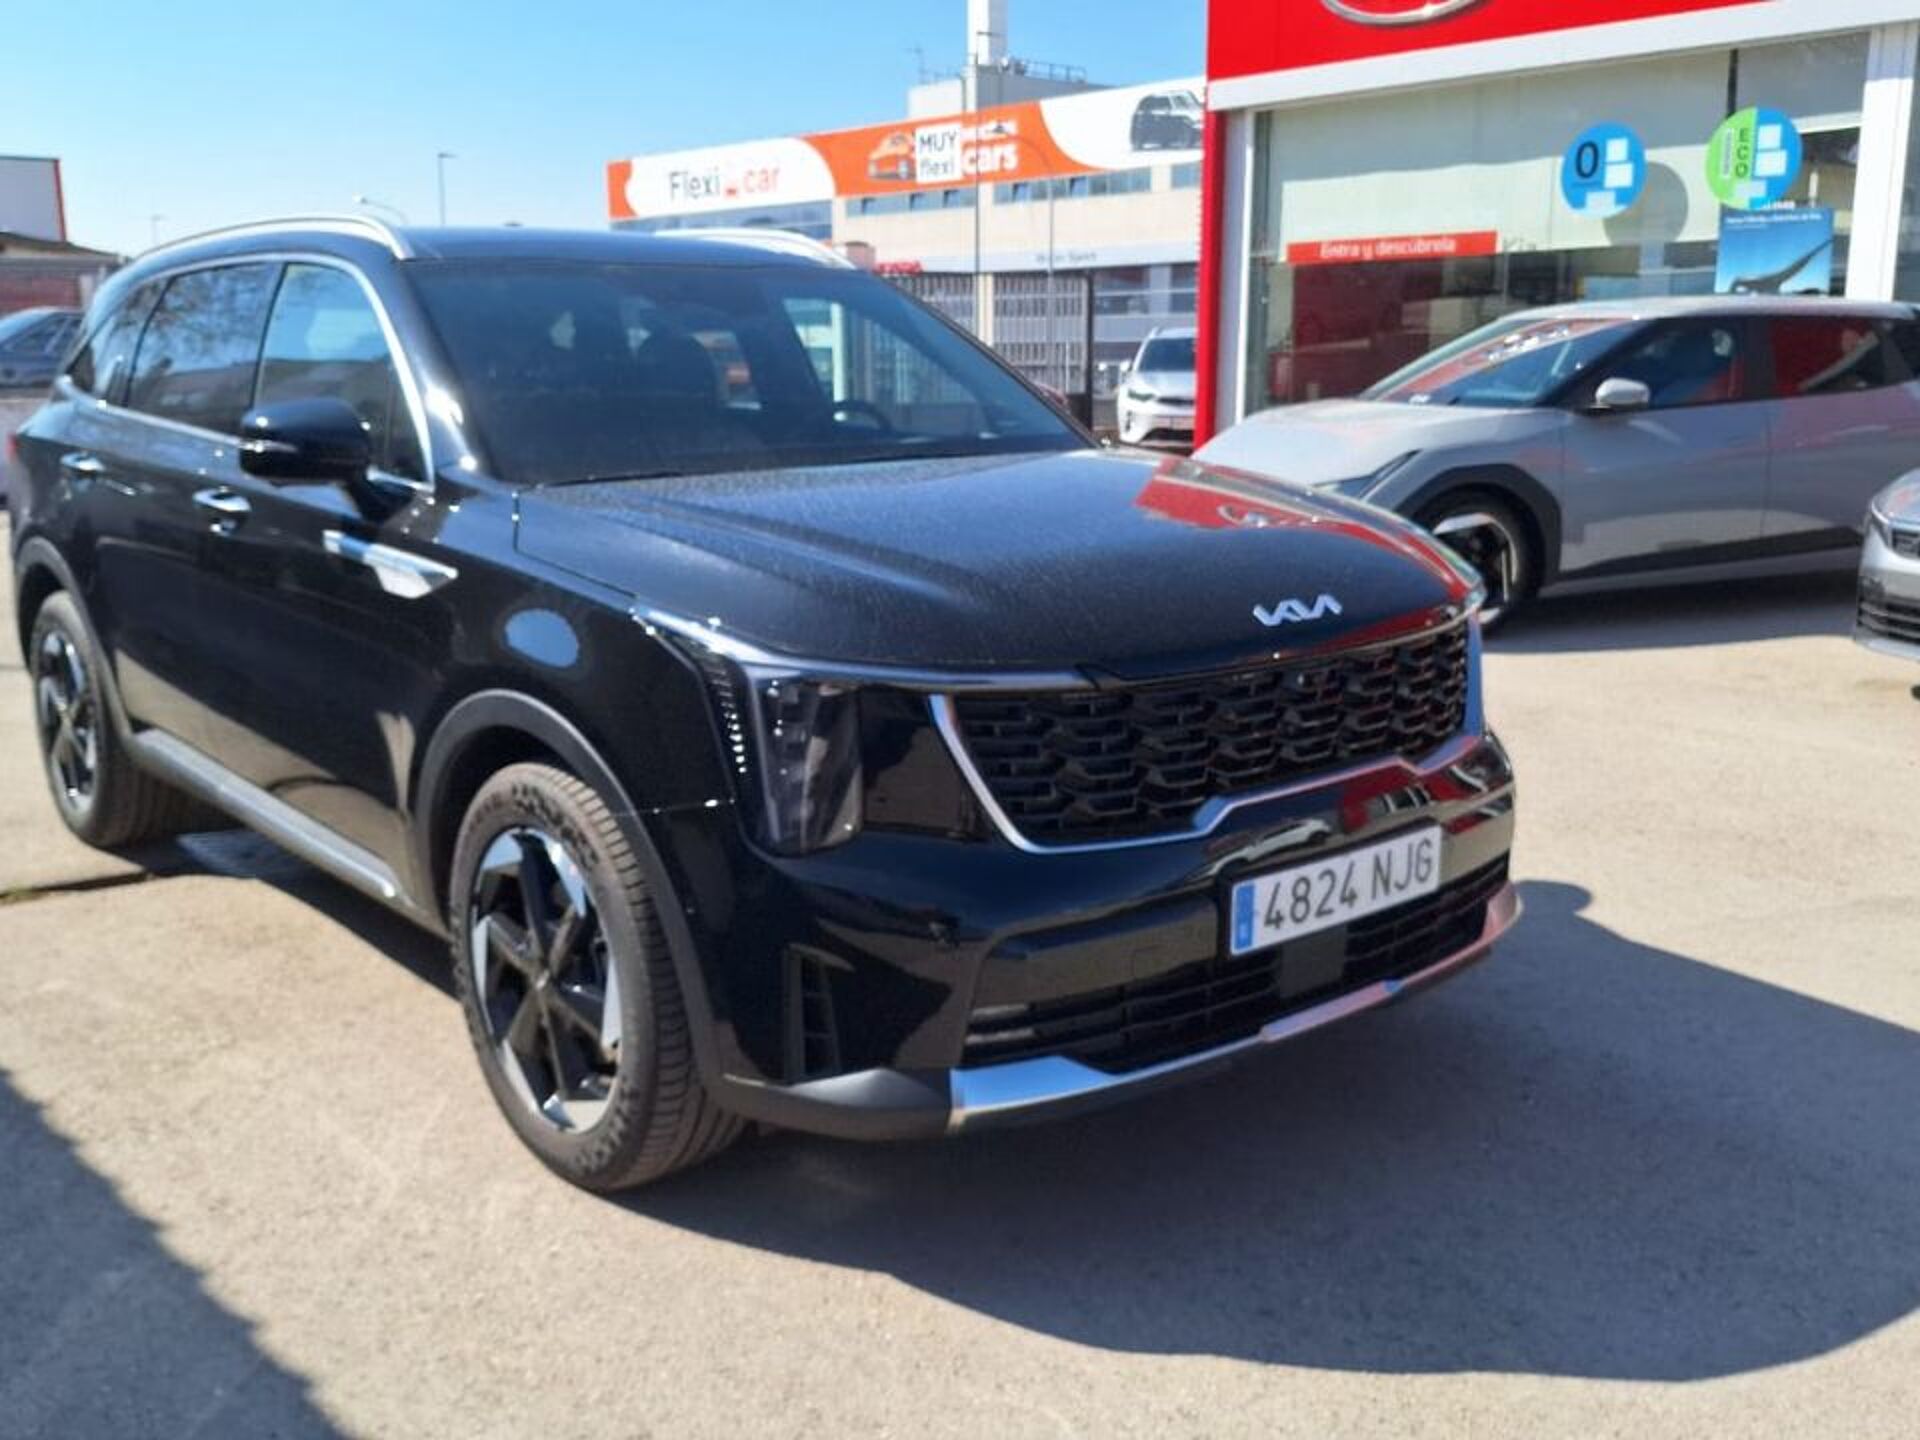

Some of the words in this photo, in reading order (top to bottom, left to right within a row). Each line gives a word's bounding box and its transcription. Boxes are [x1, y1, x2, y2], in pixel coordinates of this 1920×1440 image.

[919, 130, 959, 154] MUY
[961, 144, 1017, 175] cars
[1575, 140, 1599, 179] 0
[1735, 127, 1750, 178] ECO
[1264, 860, 1358, 930] 4824
[1371, 837, 1433, 900] NJG
